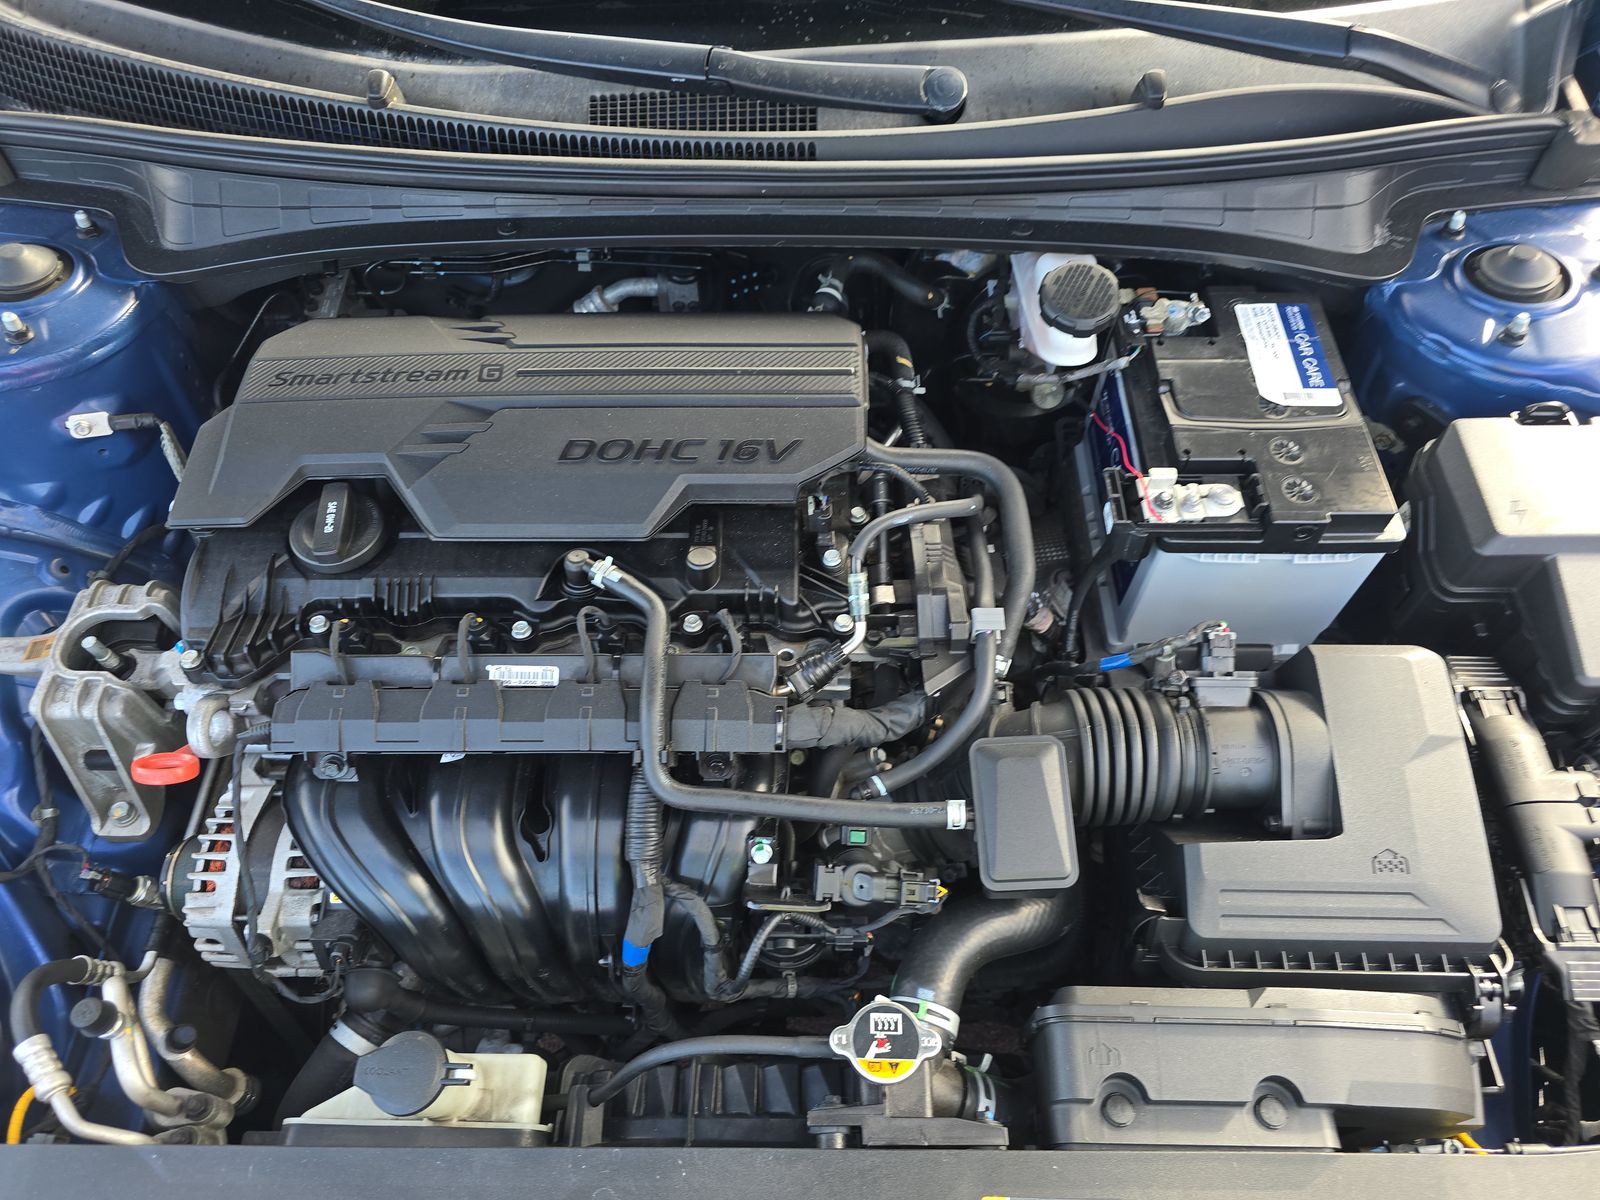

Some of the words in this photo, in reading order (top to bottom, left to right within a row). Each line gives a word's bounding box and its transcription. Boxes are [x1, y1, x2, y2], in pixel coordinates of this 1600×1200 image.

[1294, 333, 1315, 356] CAR
[268, 368, 470, 388] Smartstream
[1302, 357, 1326, 388] CARE
[557, 438, 708, 463] DOHC
[717, 438, 804, 463] 16V
[326, 501, 338, 514] SAE
[323, 513, 336, 534] 0W-20
